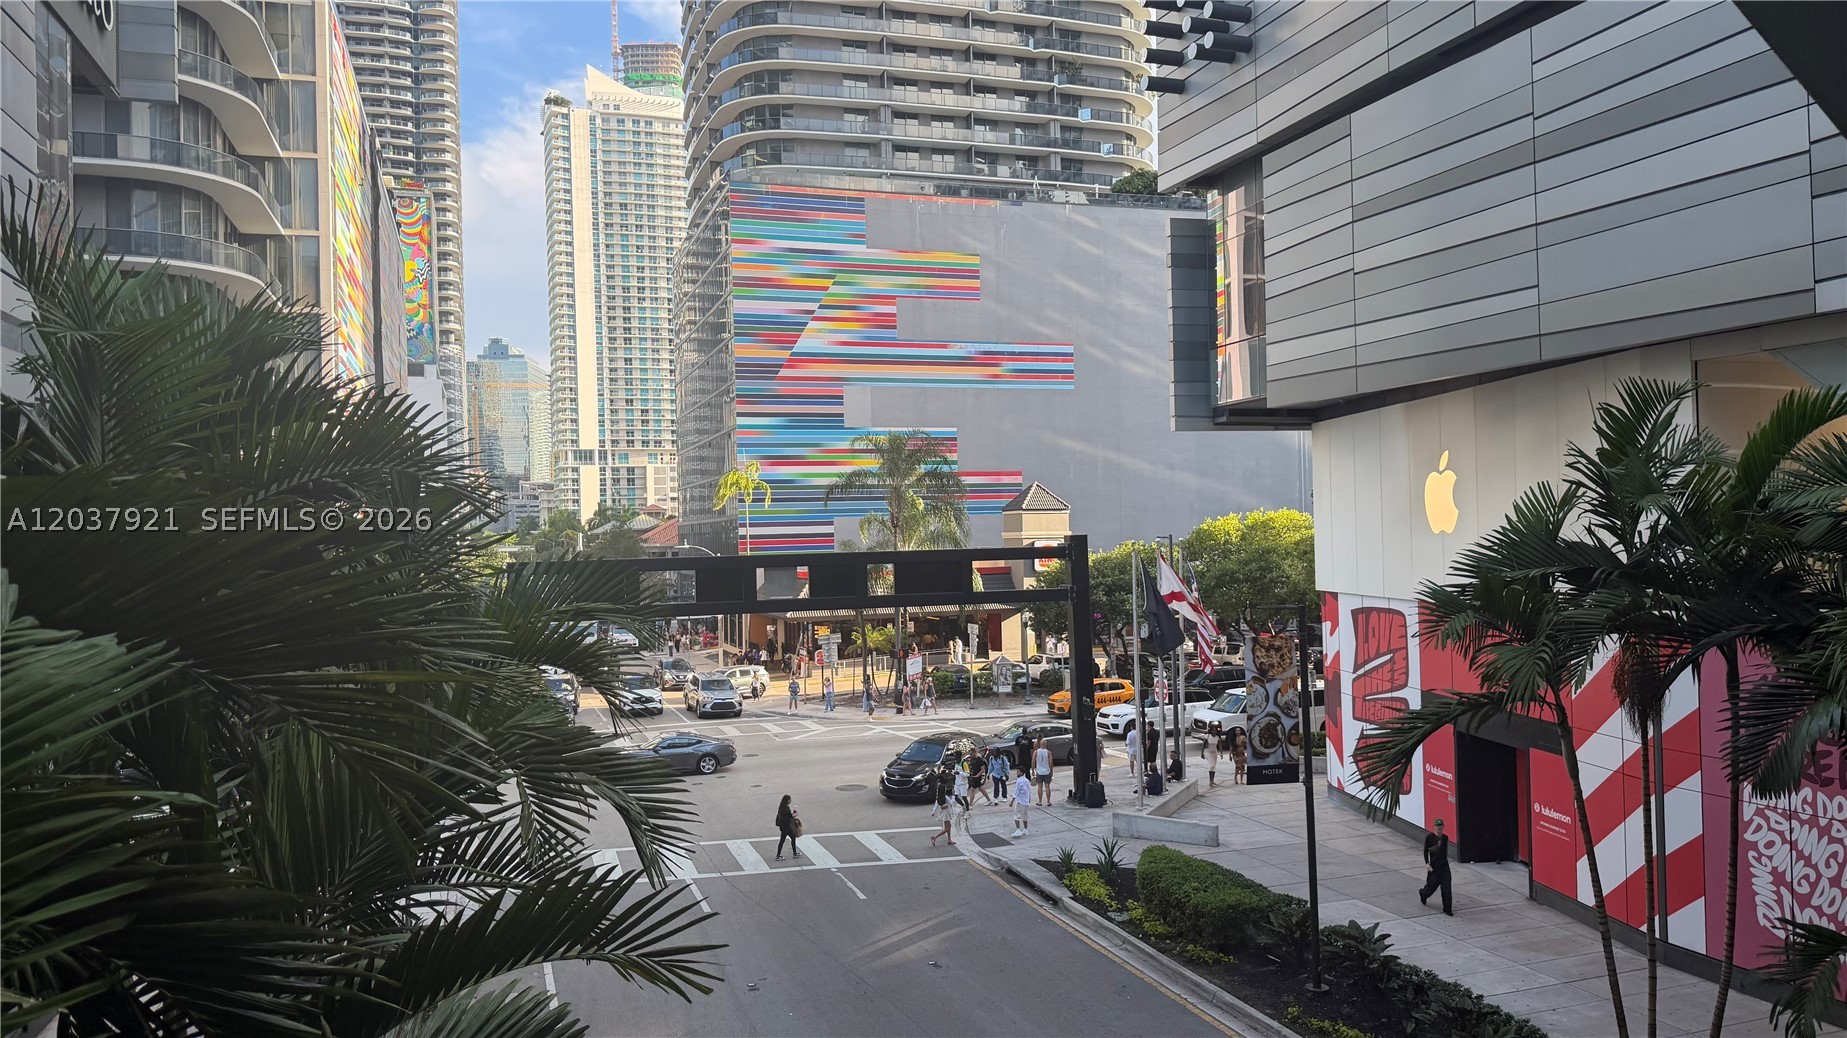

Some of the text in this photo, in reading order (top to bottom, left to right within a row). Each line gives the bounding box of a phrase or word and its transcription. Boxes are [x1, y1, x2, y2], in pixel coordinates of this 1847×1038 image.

[1357, 611, 1407, 665] LOVE
[1541, 804, 1571, 824] lululemon
[1764, 809, 1844, 878] DOING
[1744, 816, 1816, 894] DOING
